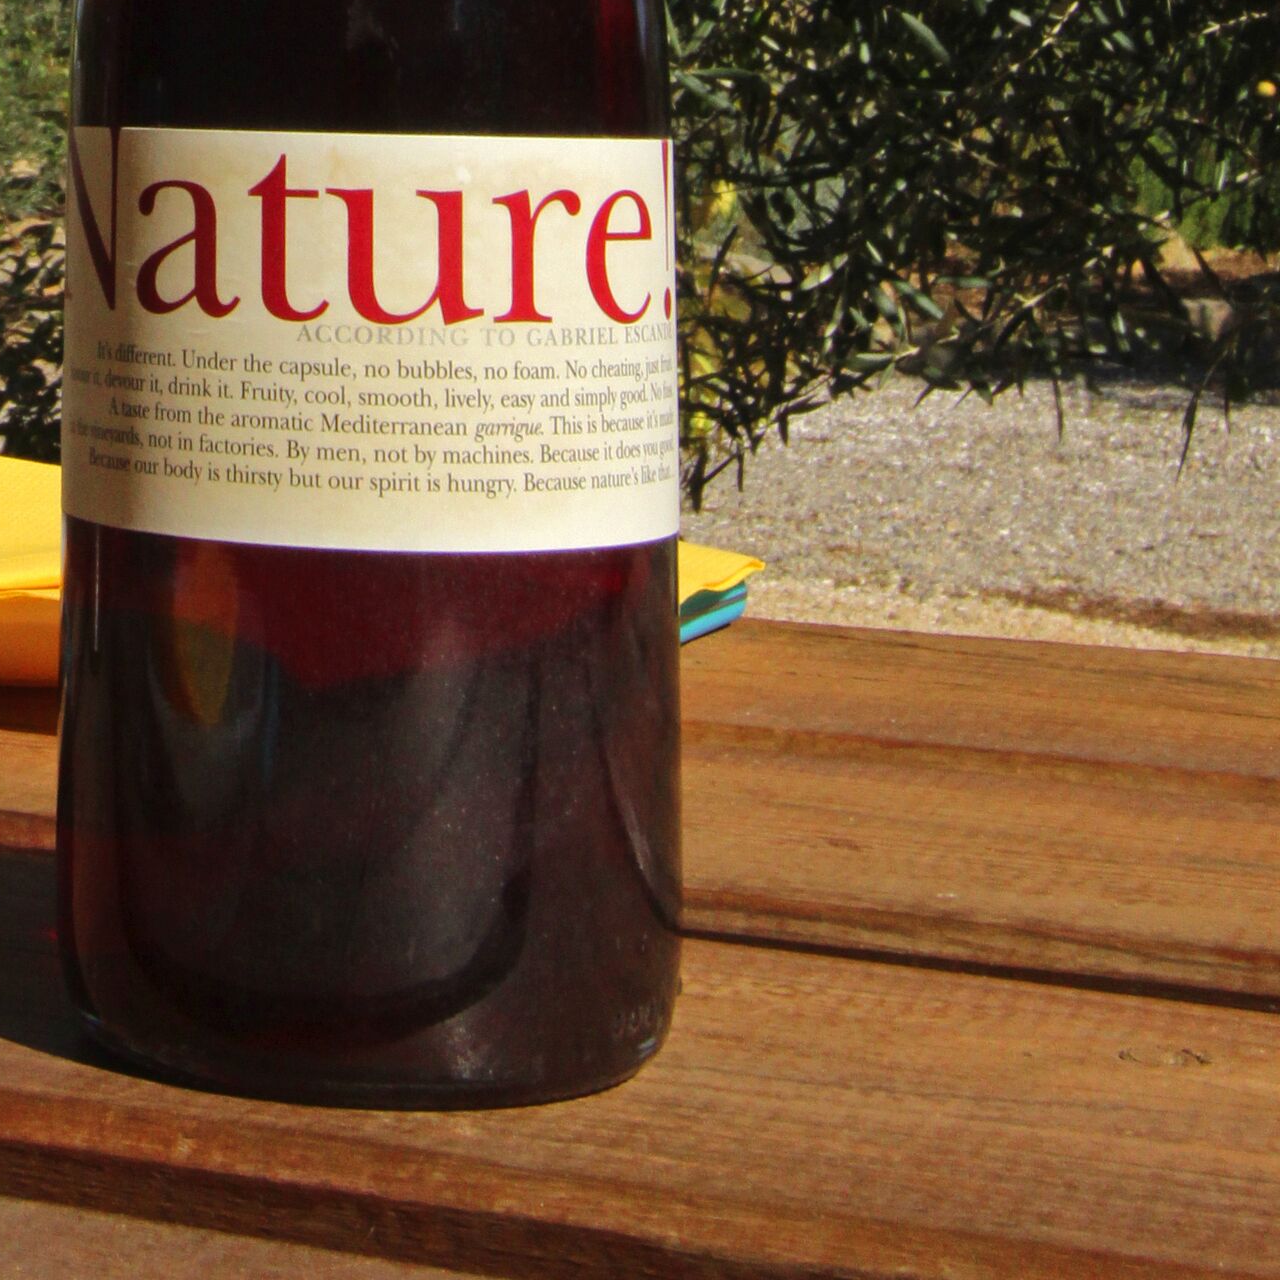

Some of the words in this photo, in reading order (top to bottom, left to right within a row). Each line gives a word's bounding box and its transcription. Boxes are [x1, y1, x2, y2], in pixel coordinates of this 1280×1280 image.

[296, 324, 470, 347] ACCORDING
[479, 328, 515, 347] TO
[527, 326, 618, 347] GABRIEL
[115, 343, 175, 367] different.
[182, 348, 237, 372] Under
[244, 353, 272, 373] the
[279, 357, 356, 381] capsule,
[364, 364, 390, 378] no
[397, 359, 477, 382] bubbles,
[484, 366, 507, 380] no
[513, 360, 559, 380] foam.
[565, 360, 587, 379] No
[592, 357, 643, 381] cheating,
[150, 374, 163, 395] it,
[168, 377, 212, 397] drink
[218, 379, 233, 399] it.
[240, 380, 297, 408] Fruity,
[304, 385, 352, 408] cool,
[358, 387, 438, 409] smooth,
[444, 388, 495, 414] lively,
[500, 394, 535, 414] easy
[540, 387, 570, 408] and
[574, 385, 617, 412] simply
[620, 383, 648, 410] good.
[121, 400, 150, 420] taste
[154, 402, 192, 423] from
[197, 406, 225, 425] the
[231, 411, 313, 432] aromatic
[320, 413, 467, 436] Mediterranean
[474, 416, 545, 443] garrigue.
[550, 415, 583, 435] This
[587, 414, 598, 434] is
[601, 413, 645, 434] because
[148, 432, 172, 449] not
[178, 431, 193, 452] in
[198, 433, 279, 458] factories.
[286, 440, 310, 466] By
[316, 448, 367, 464] men,
[374, 446, 408, 464] not
[414, 444, 437, 470] by
[442, 444, 534, 465] machines.
[539, 443, 600, 465] Because
[604, 441, 613, 460] it
[616, 440, 641, 460] does
[134, 458, 159, 475] our
[164, 457, 203, 486] body
[208, 461, 220, 482] is
[226, 463, 283, 492] thirsty
[289, 467, 325, 489] but
[328, 475, 364, 491] our
[369, 472, 421, 498] spirit
[427, 473, 441, 492] is
[447, 472, 517, 499] hungry.
[524, 472, 587, 493] Because
[591, 467, 639, 490] nature's
